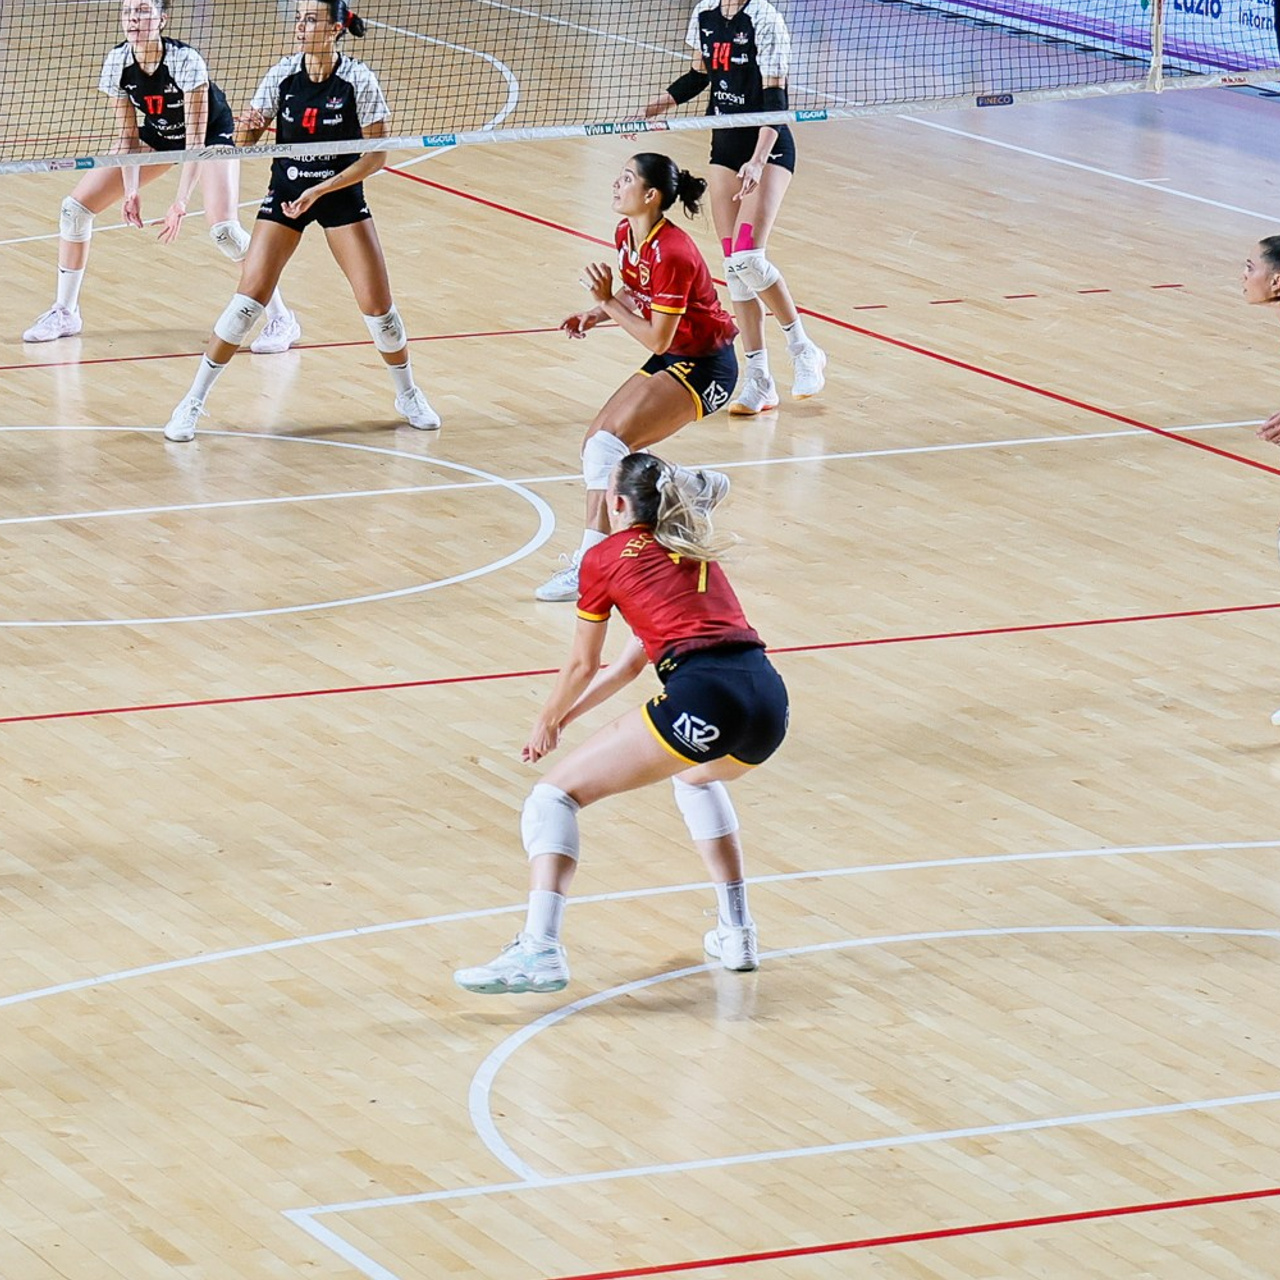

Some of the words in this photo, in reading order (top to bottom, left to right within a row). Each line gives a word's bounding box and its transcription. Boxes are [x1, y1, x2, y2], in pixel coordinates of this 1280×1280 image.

[1239, 5, 1274, 32] intorn
[711, 42, 732, 72] 14
[143, 94, 164, 115] 17
[301, 107, 319, 134] 4
[244, 146, 268, 155] GROUP
